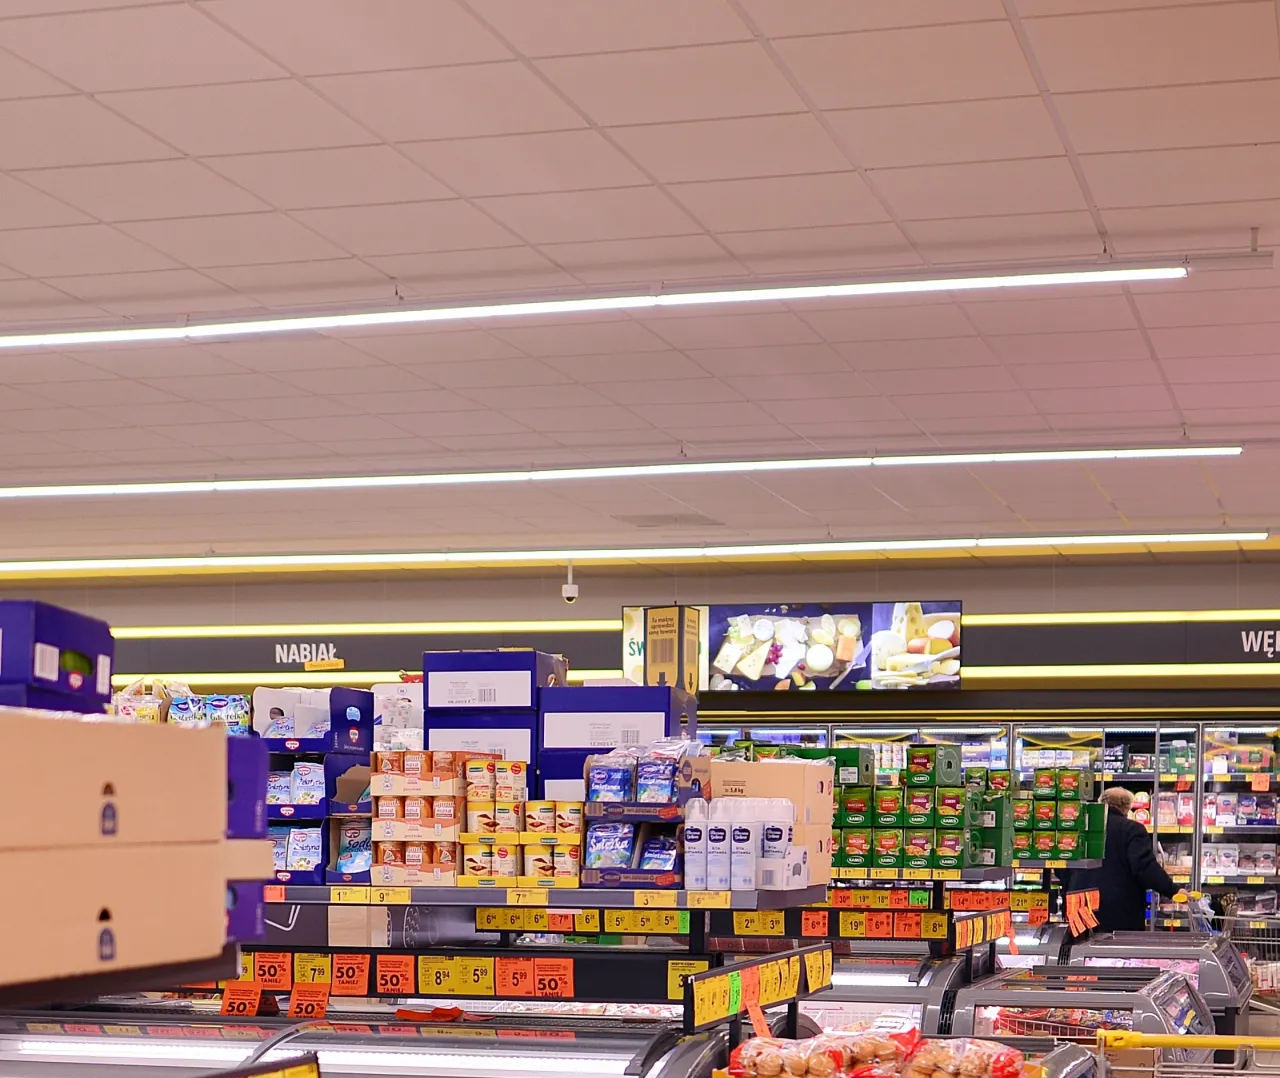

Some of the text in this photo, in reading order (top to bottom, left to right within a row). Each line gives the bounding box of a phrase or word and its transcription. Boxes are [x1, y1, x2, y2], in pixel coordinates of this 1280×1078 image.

[275, 643, 339, 664] NABIAŁ
[258, 964, 287, 977] 50%
[310, 967, 325, 983] 799
[335, 965, 365, 979] 50%
[435, 970, 450, 985] 894
[472, 968, 487, 983] 599
[380, 974, 409, 987] 50%
[512, 972, 527, 986] 599
[537, 976, 568, 991] 50%
